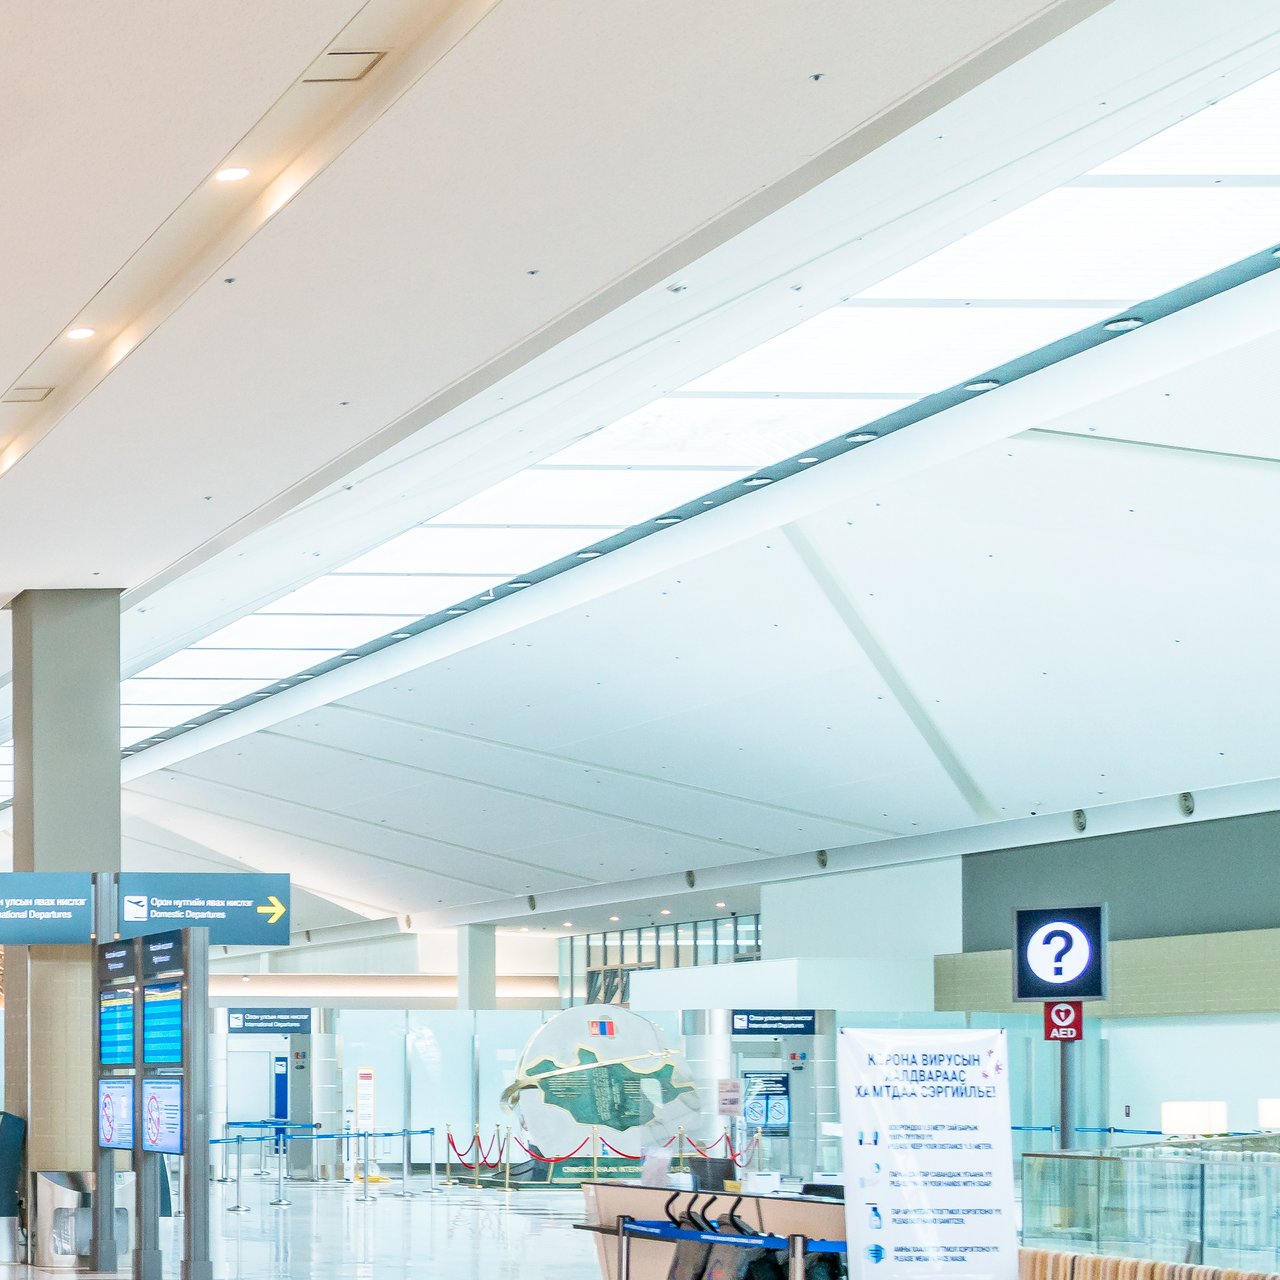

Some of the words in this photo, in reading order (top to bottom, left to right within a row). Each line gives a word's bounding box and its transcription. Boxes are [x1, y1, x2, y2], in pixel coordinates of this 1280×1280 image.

[28, 909, 72, 920] Departures
[150, 909, 184, 918] Domestic
[185, 909, 226, 920] Departures
[1050, 1028, 1077, 1038] AED
[867, 1053, 918, 1066] КРОНА
[921, 1053, 981, 1066] ВИРУСЫН
[885, 1069, 966, 1083] АЛДВАРААС
[920, 1083, 996, 1098] СЭРГИЙЛЬЕ!
